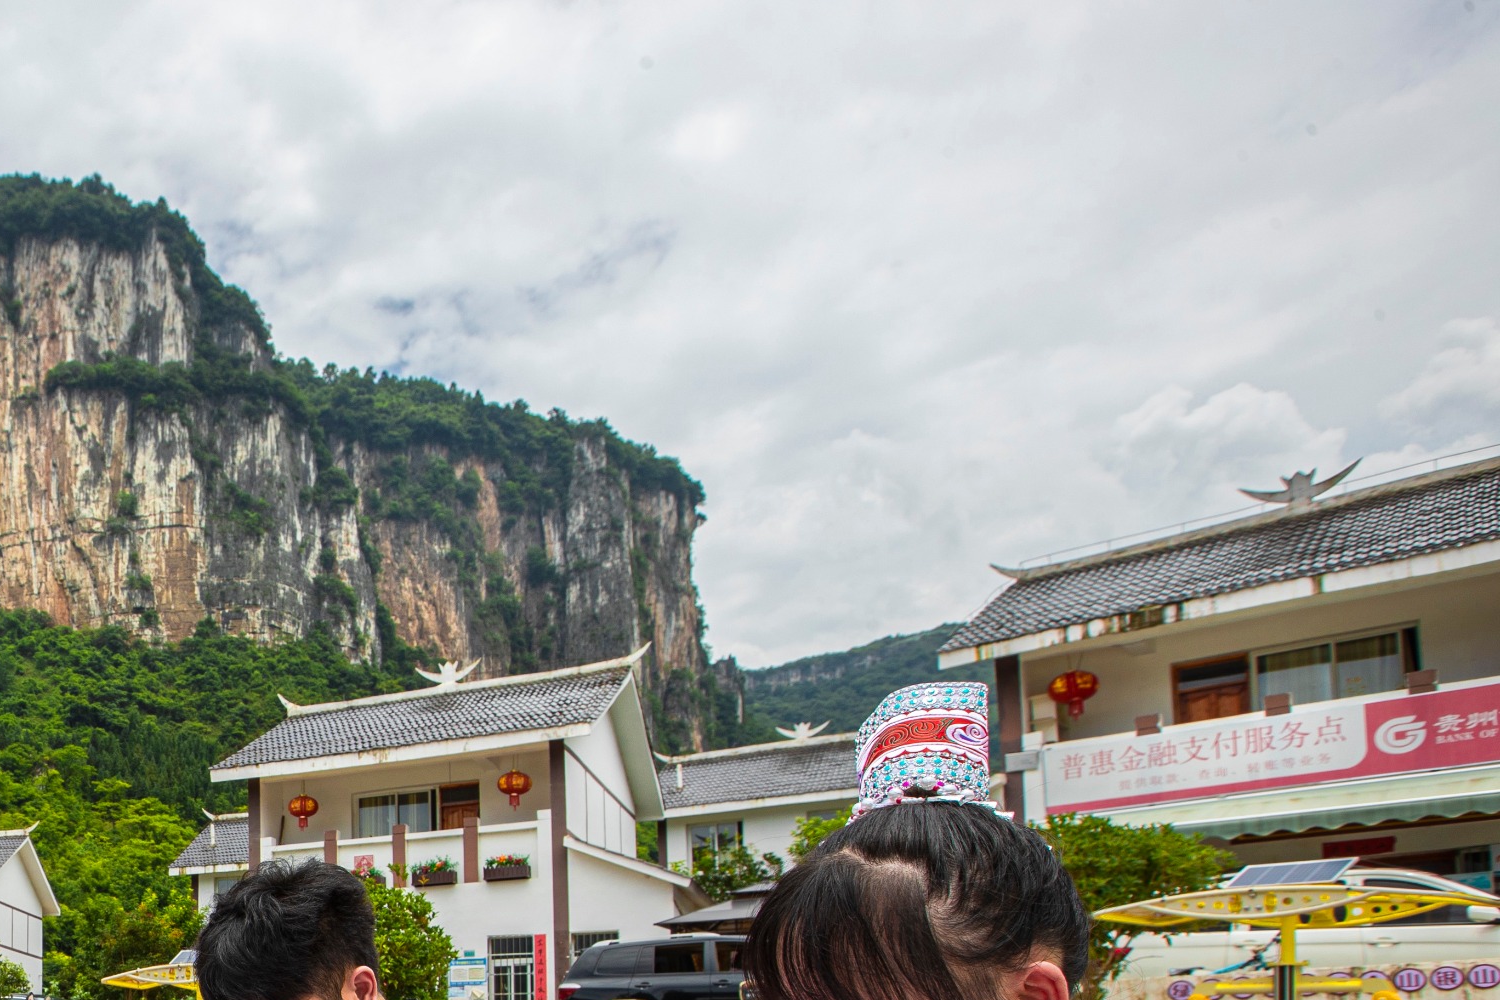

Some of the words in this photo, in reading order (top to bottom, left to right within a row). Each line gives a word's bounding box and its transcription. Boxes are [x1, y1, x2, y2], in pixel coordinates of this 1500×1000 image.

[1433, 709, 1498, 733] 贵州
[1059, 715, 1348, 781] 普惠金融支付服务点
[1435, 731, 1476, 744] BANK
[1479, 728, 1498, 739] OF
